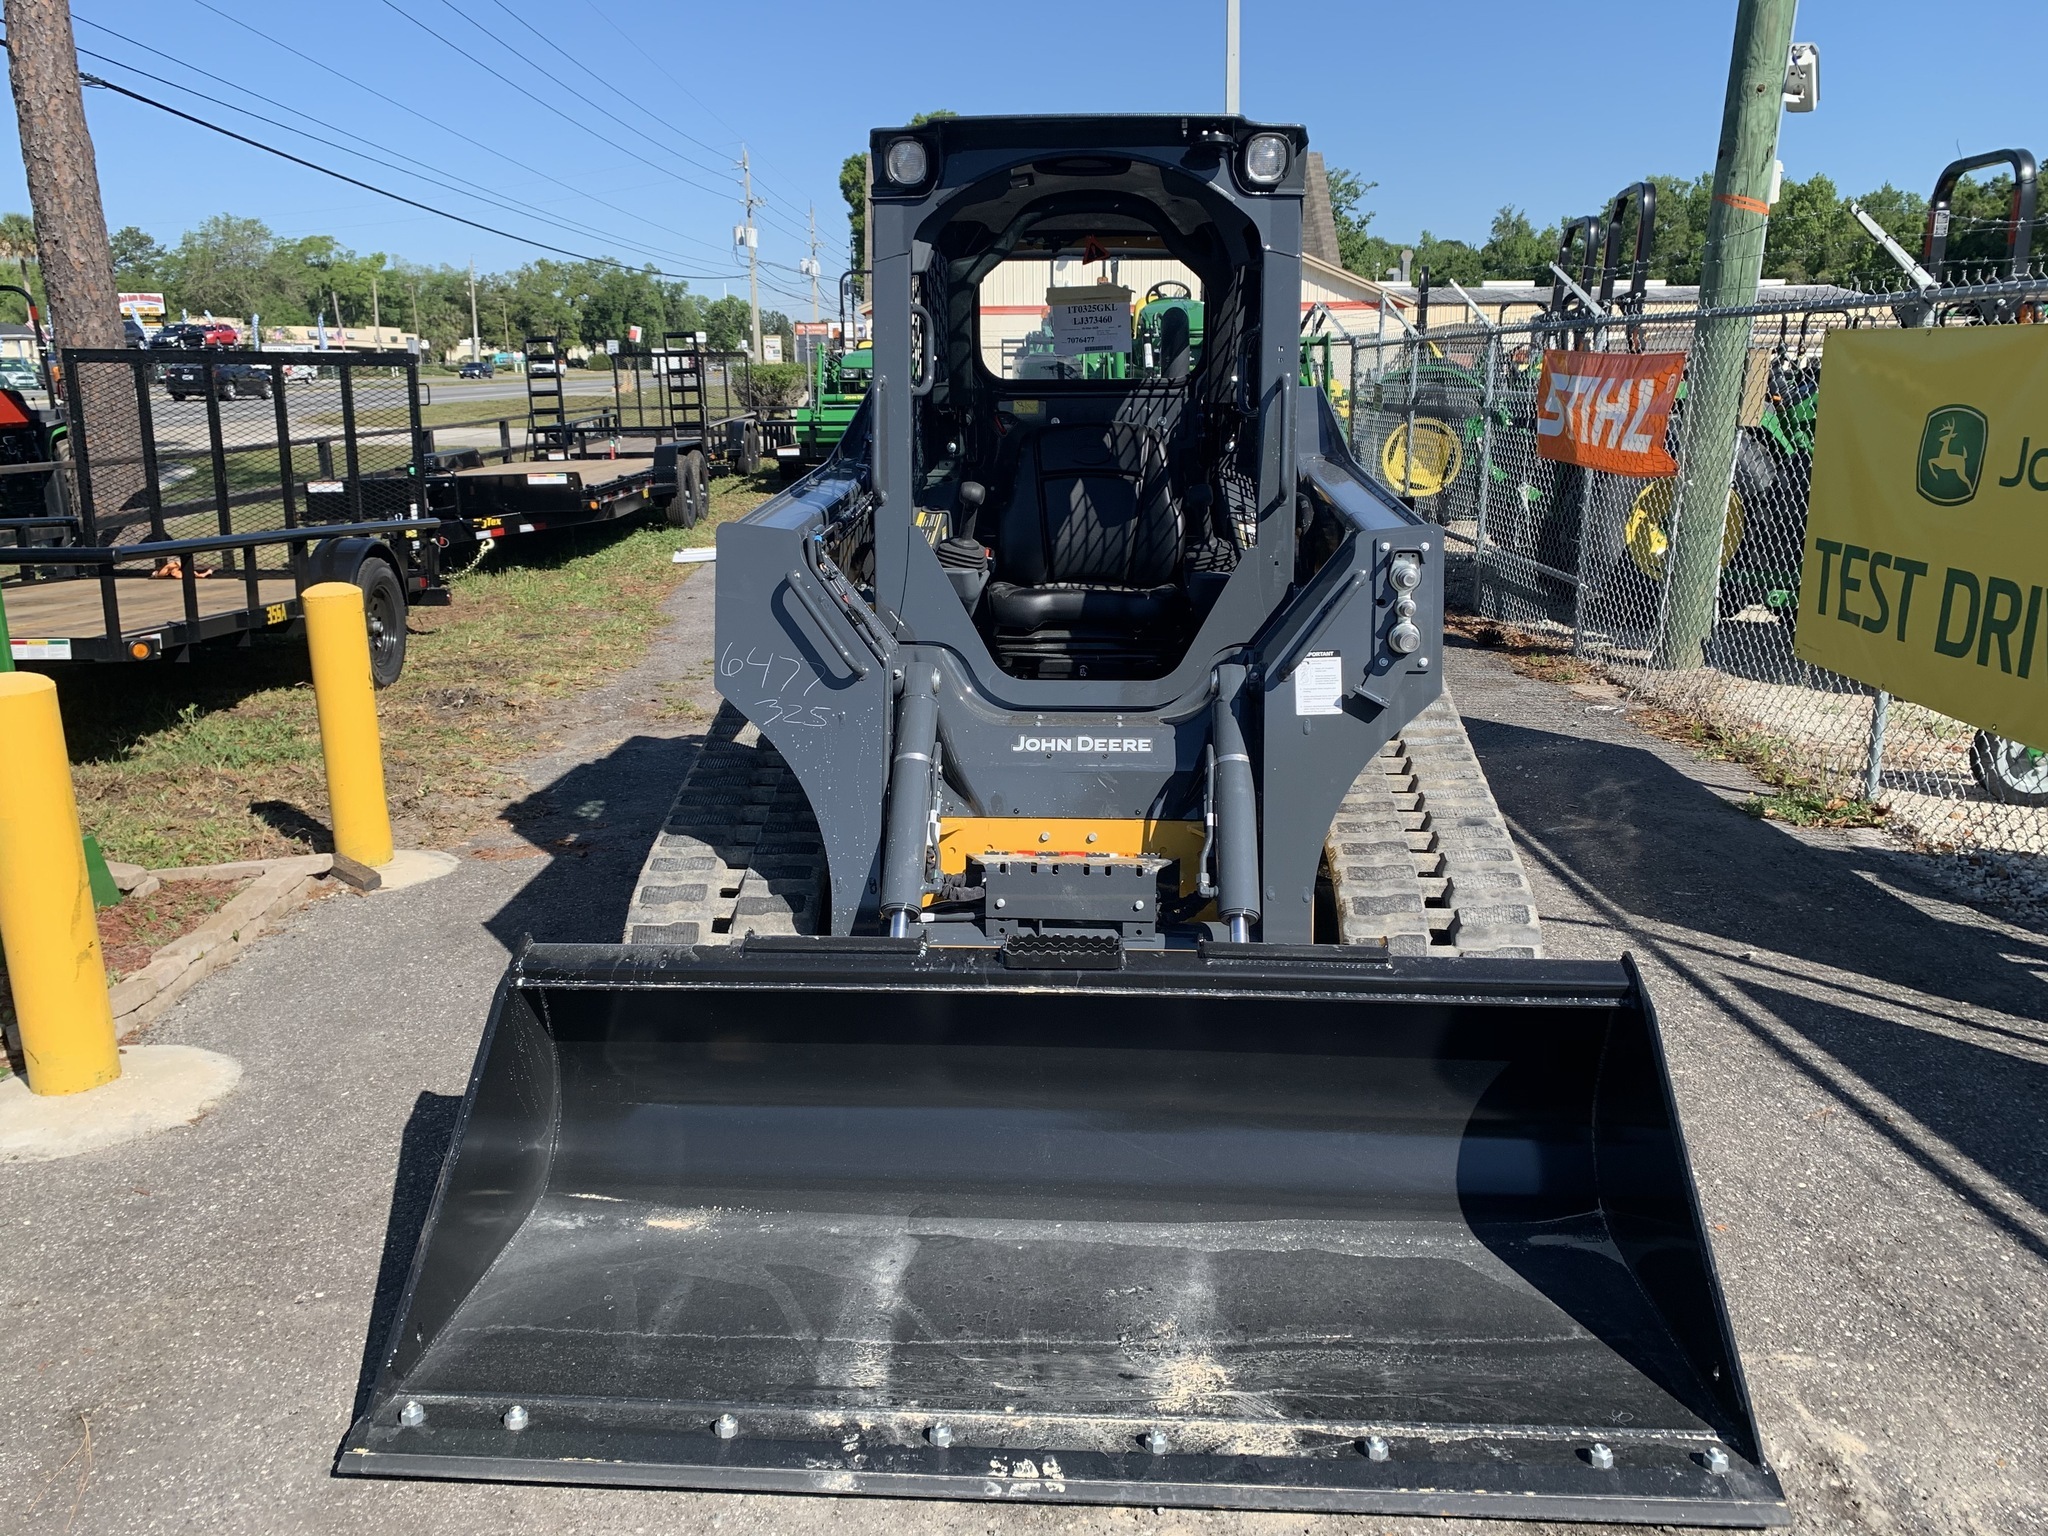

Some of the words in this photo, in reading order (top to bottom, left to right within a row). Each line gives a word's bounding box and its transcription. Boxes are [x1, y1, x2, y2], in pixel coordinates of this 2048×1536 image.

[1067, 303, 1118, 314] 1T0325GKL
[1073, 315, 1113, 325] LJ373460
[1067, 336, 1095, 344] 7076477
[1537, 372, 1655, 454] STIHL
[1815, 537, 1929, 643] TEST
[1934, 567, 2048, 680] DRI
[720, 641, 826, 697] 6477
[754, 698, 832, 727] 325
[1012, 735, 1072, 752] JOHN
[1077, 735, 1152, 752] DEERE
